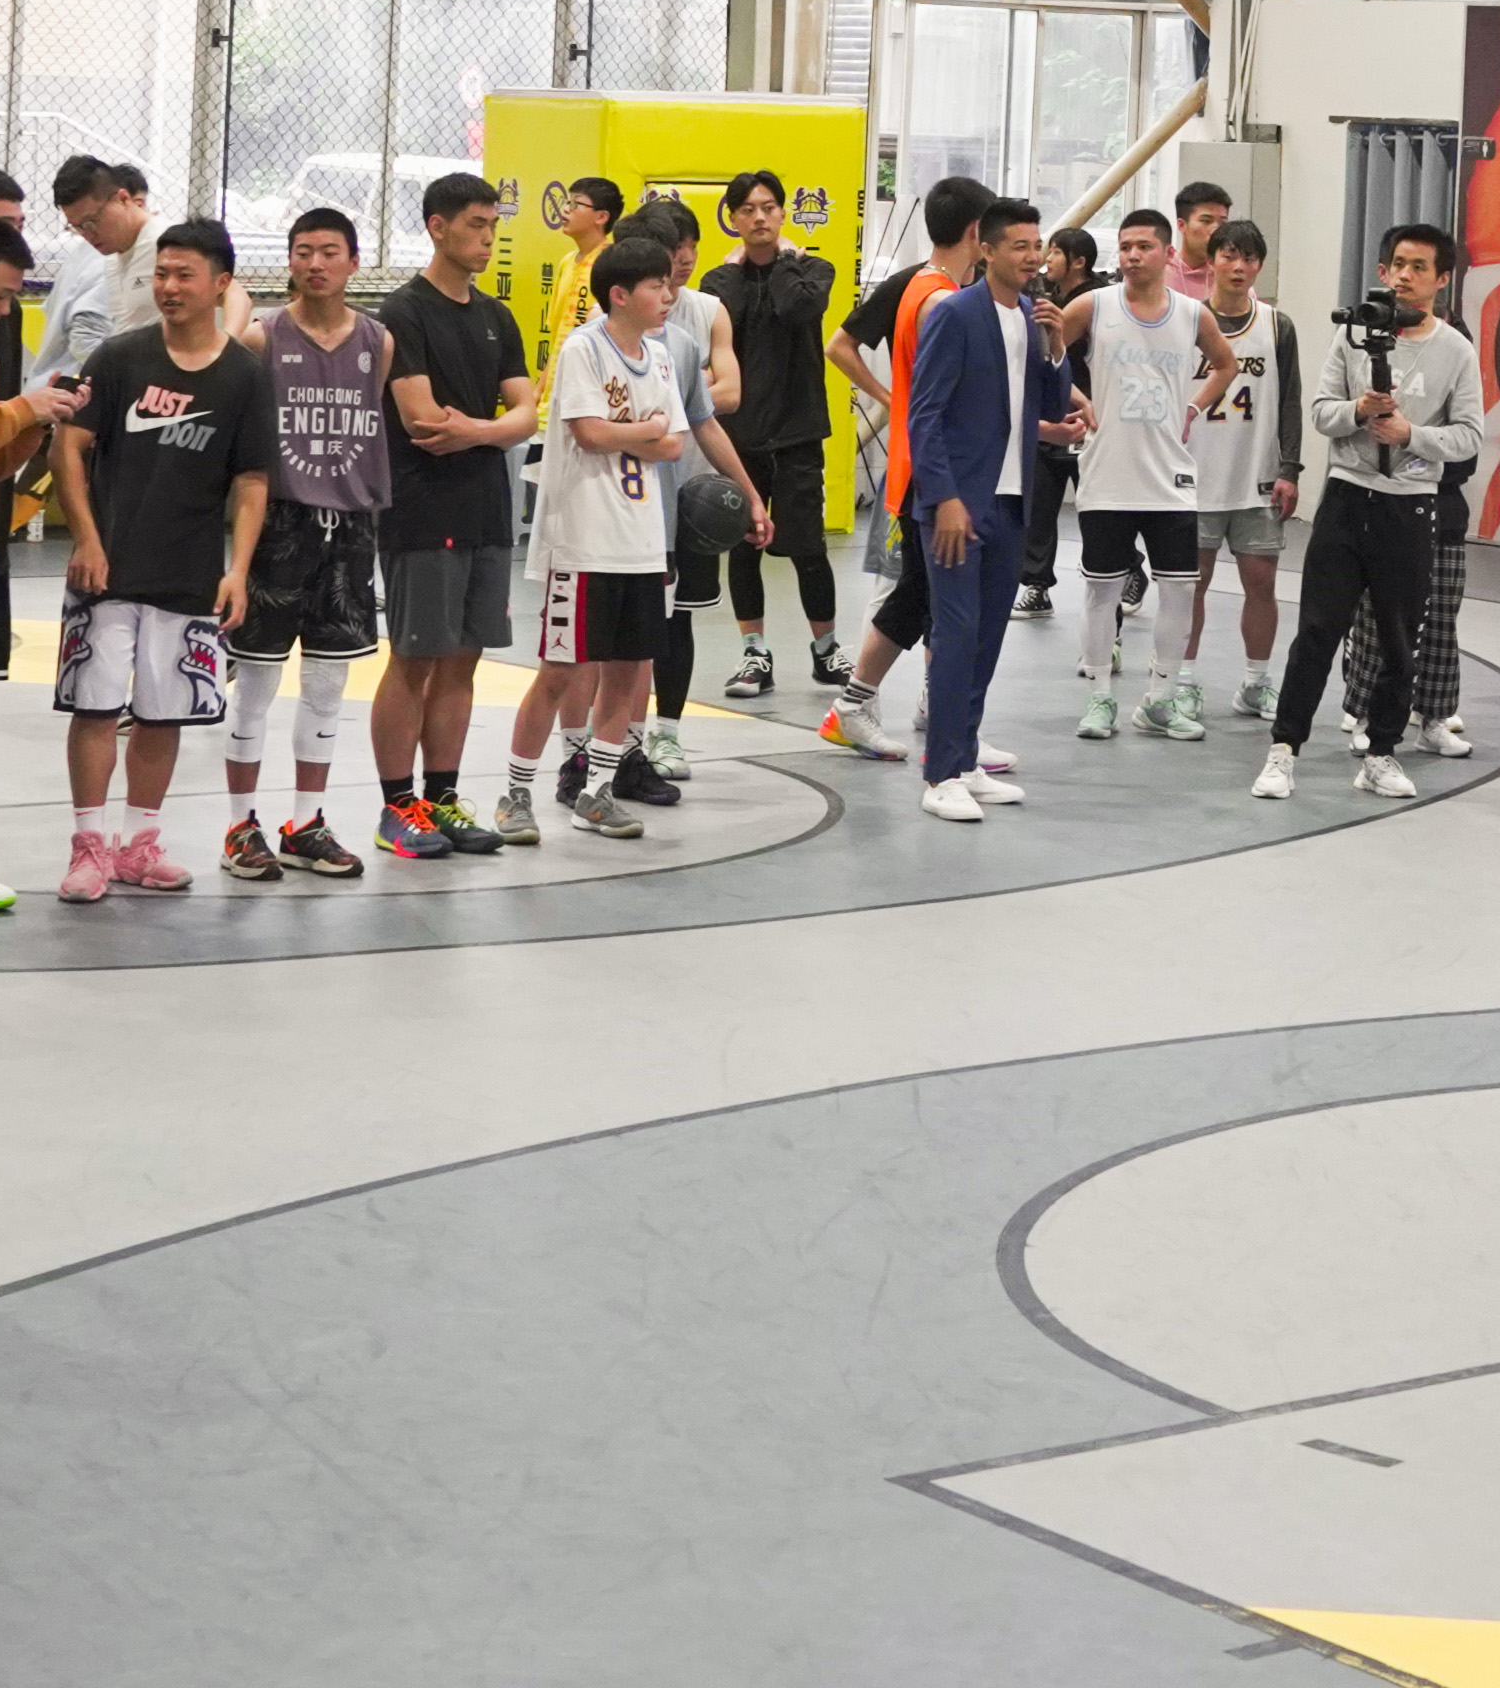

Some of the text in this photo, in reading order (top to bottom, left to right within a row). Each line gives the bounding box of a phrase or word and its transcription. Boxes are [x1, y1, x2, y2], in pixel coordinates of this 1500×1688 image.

[138, 385, 194, 416] JUST
[1119, 376, 1168, 425] 23
[278, 406, 379, 436] ENGLONG
[309, 440, 343, 455] 重庆
[620, 452, 647, 501] 8
